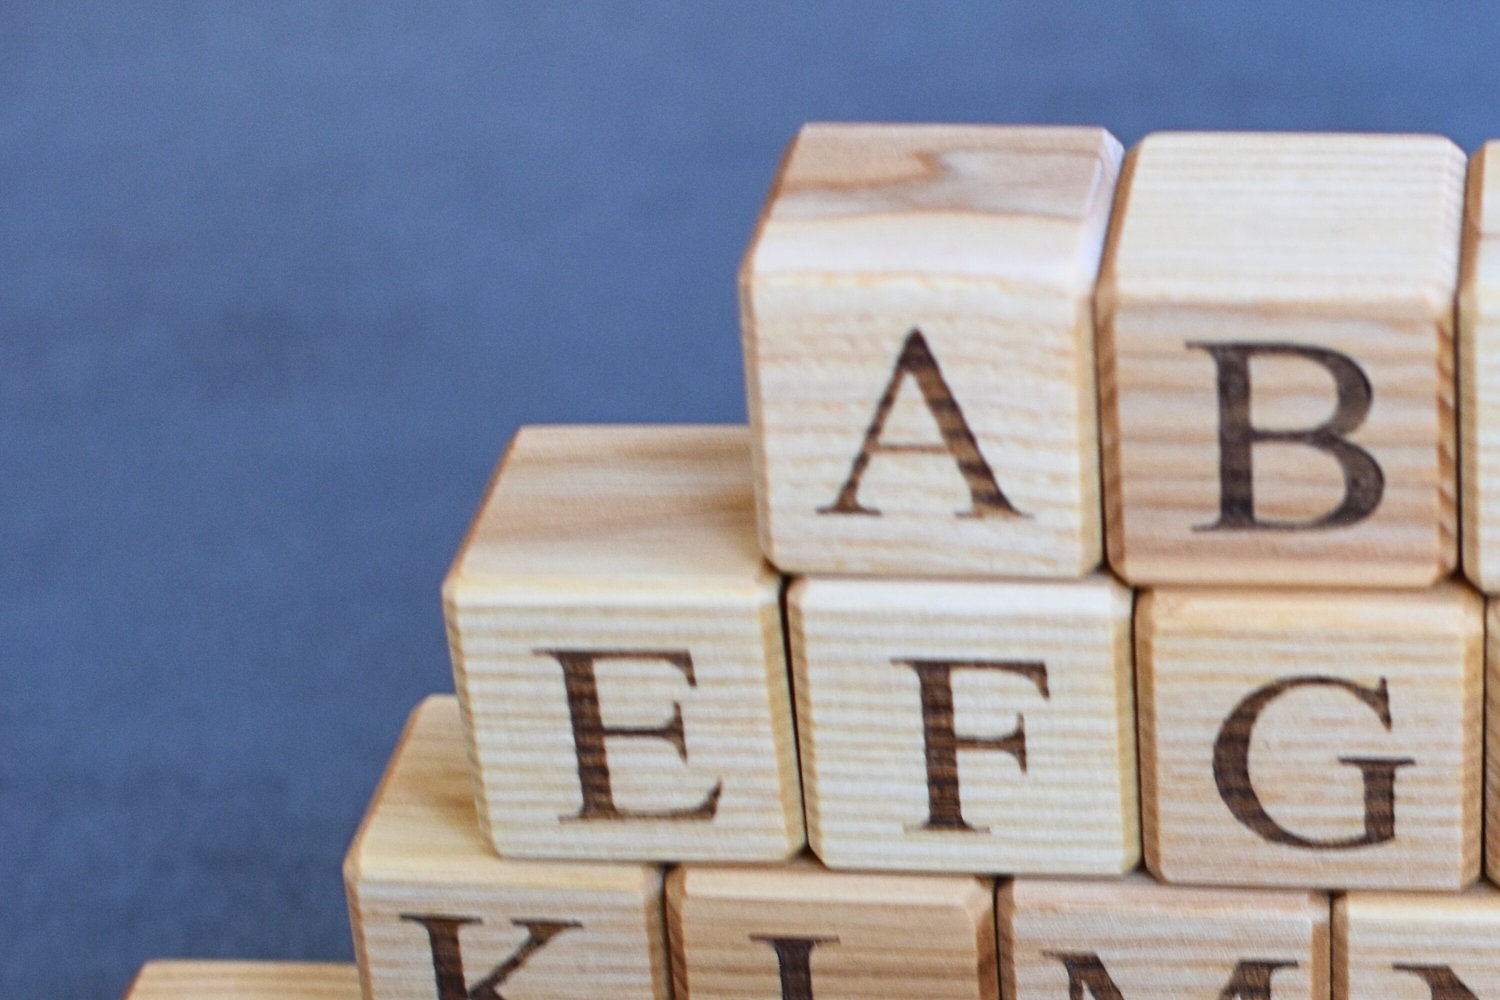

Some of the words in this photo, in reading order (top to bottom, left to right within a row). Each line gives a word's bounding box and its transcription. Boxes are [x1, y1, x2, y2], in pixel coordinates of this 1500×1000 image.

[816, 328, 1030, 519] A
[1186, 342, 1386, 532] B
[532, 649, 723, 822] E
[890, 659, 1050, 833] F
[1212, 676, 1416, 851] G
